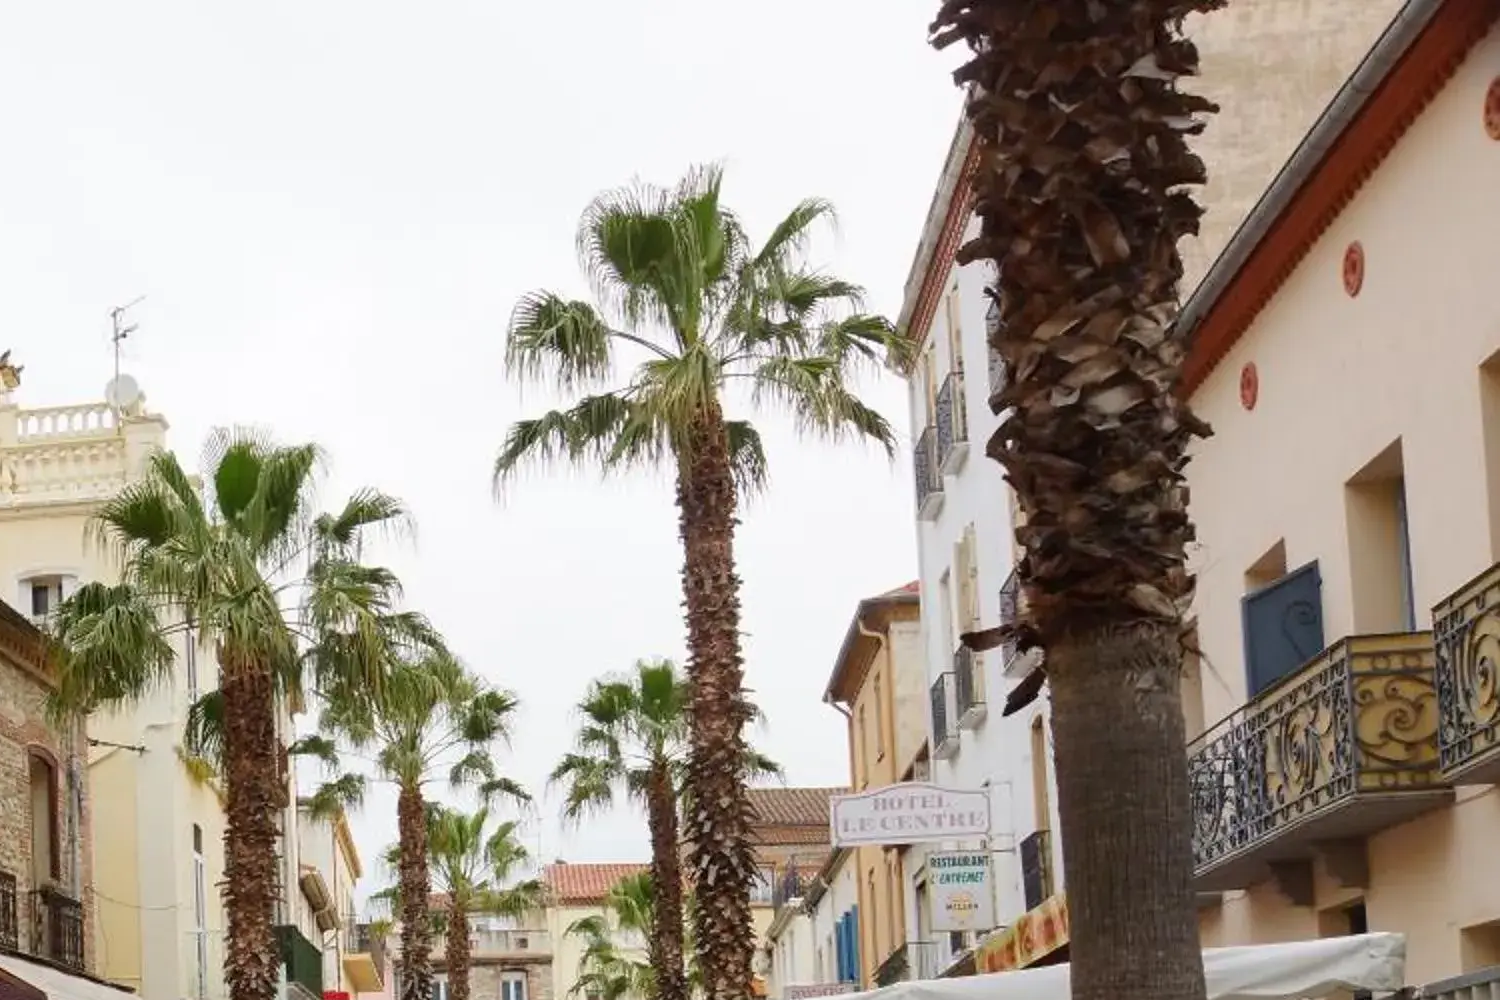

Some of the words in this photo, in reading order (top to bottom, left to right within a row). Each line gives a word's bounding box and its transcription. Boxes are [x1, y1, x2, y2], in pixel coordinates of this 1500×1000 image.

[842, 816, 877, 833] LE
[880, 811, 986, 832] CENTRE
[930, 855, 989, 868] RESTAURANT
